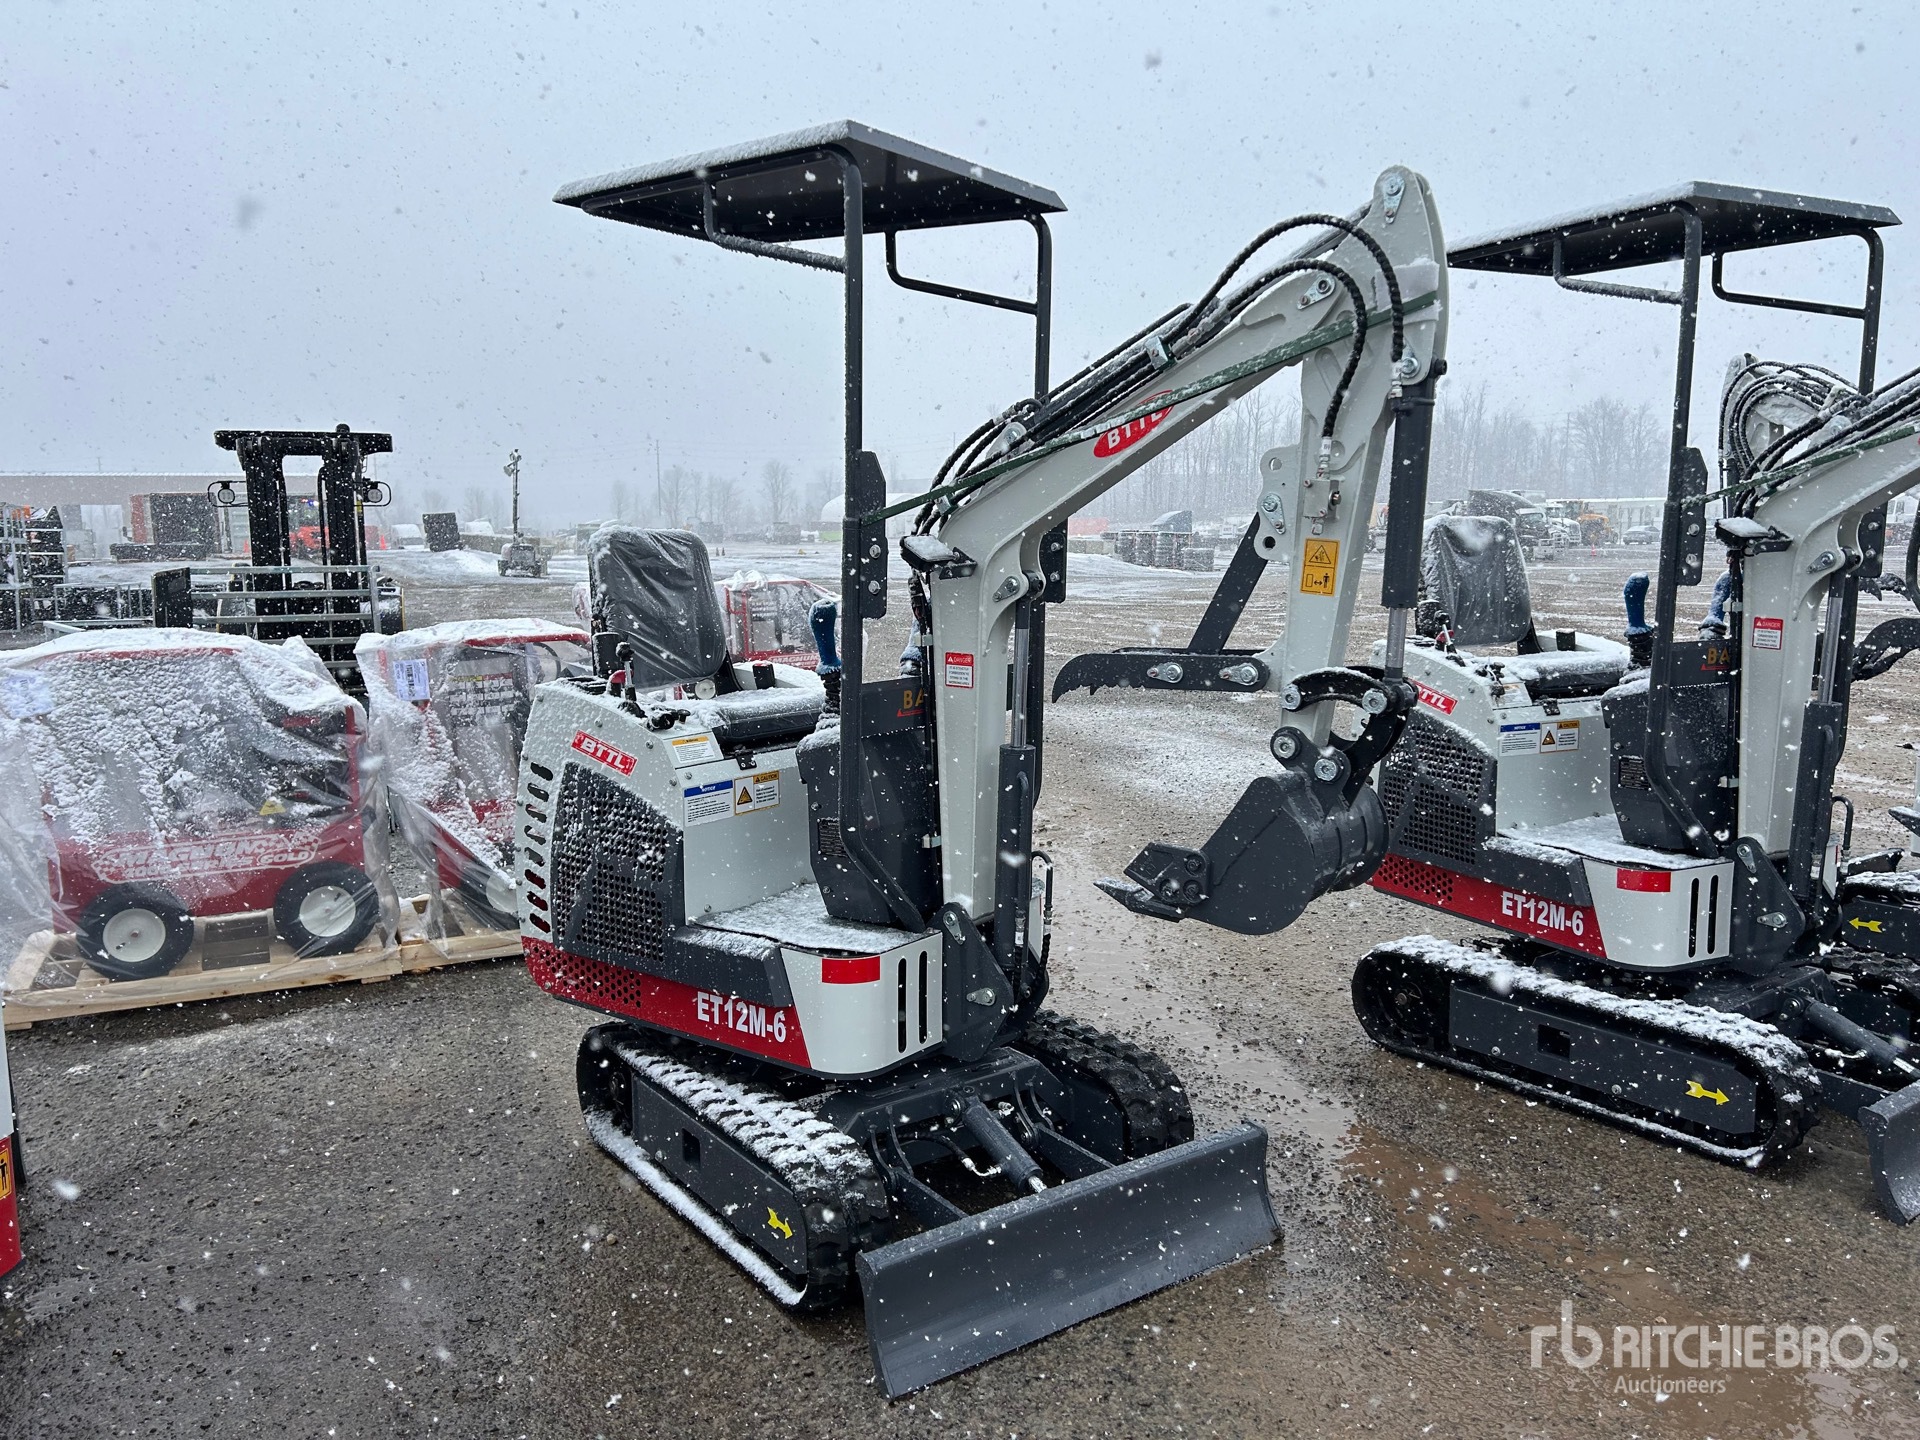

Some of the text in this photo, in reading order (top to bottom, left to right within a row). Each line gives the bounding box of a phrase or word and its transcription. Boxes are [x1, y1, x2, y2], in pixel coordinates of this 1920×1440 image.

[1416, 685, 1447, 709] TTL
[580, 737, 626, 769] BTTL
[760, 773, 778, 781] CAUTION
[261, 851, 310, 864] GOLD
[1502, 890, 1584, 936] ET12M-6
[697, 991, 787, 1043] ET12M-6
